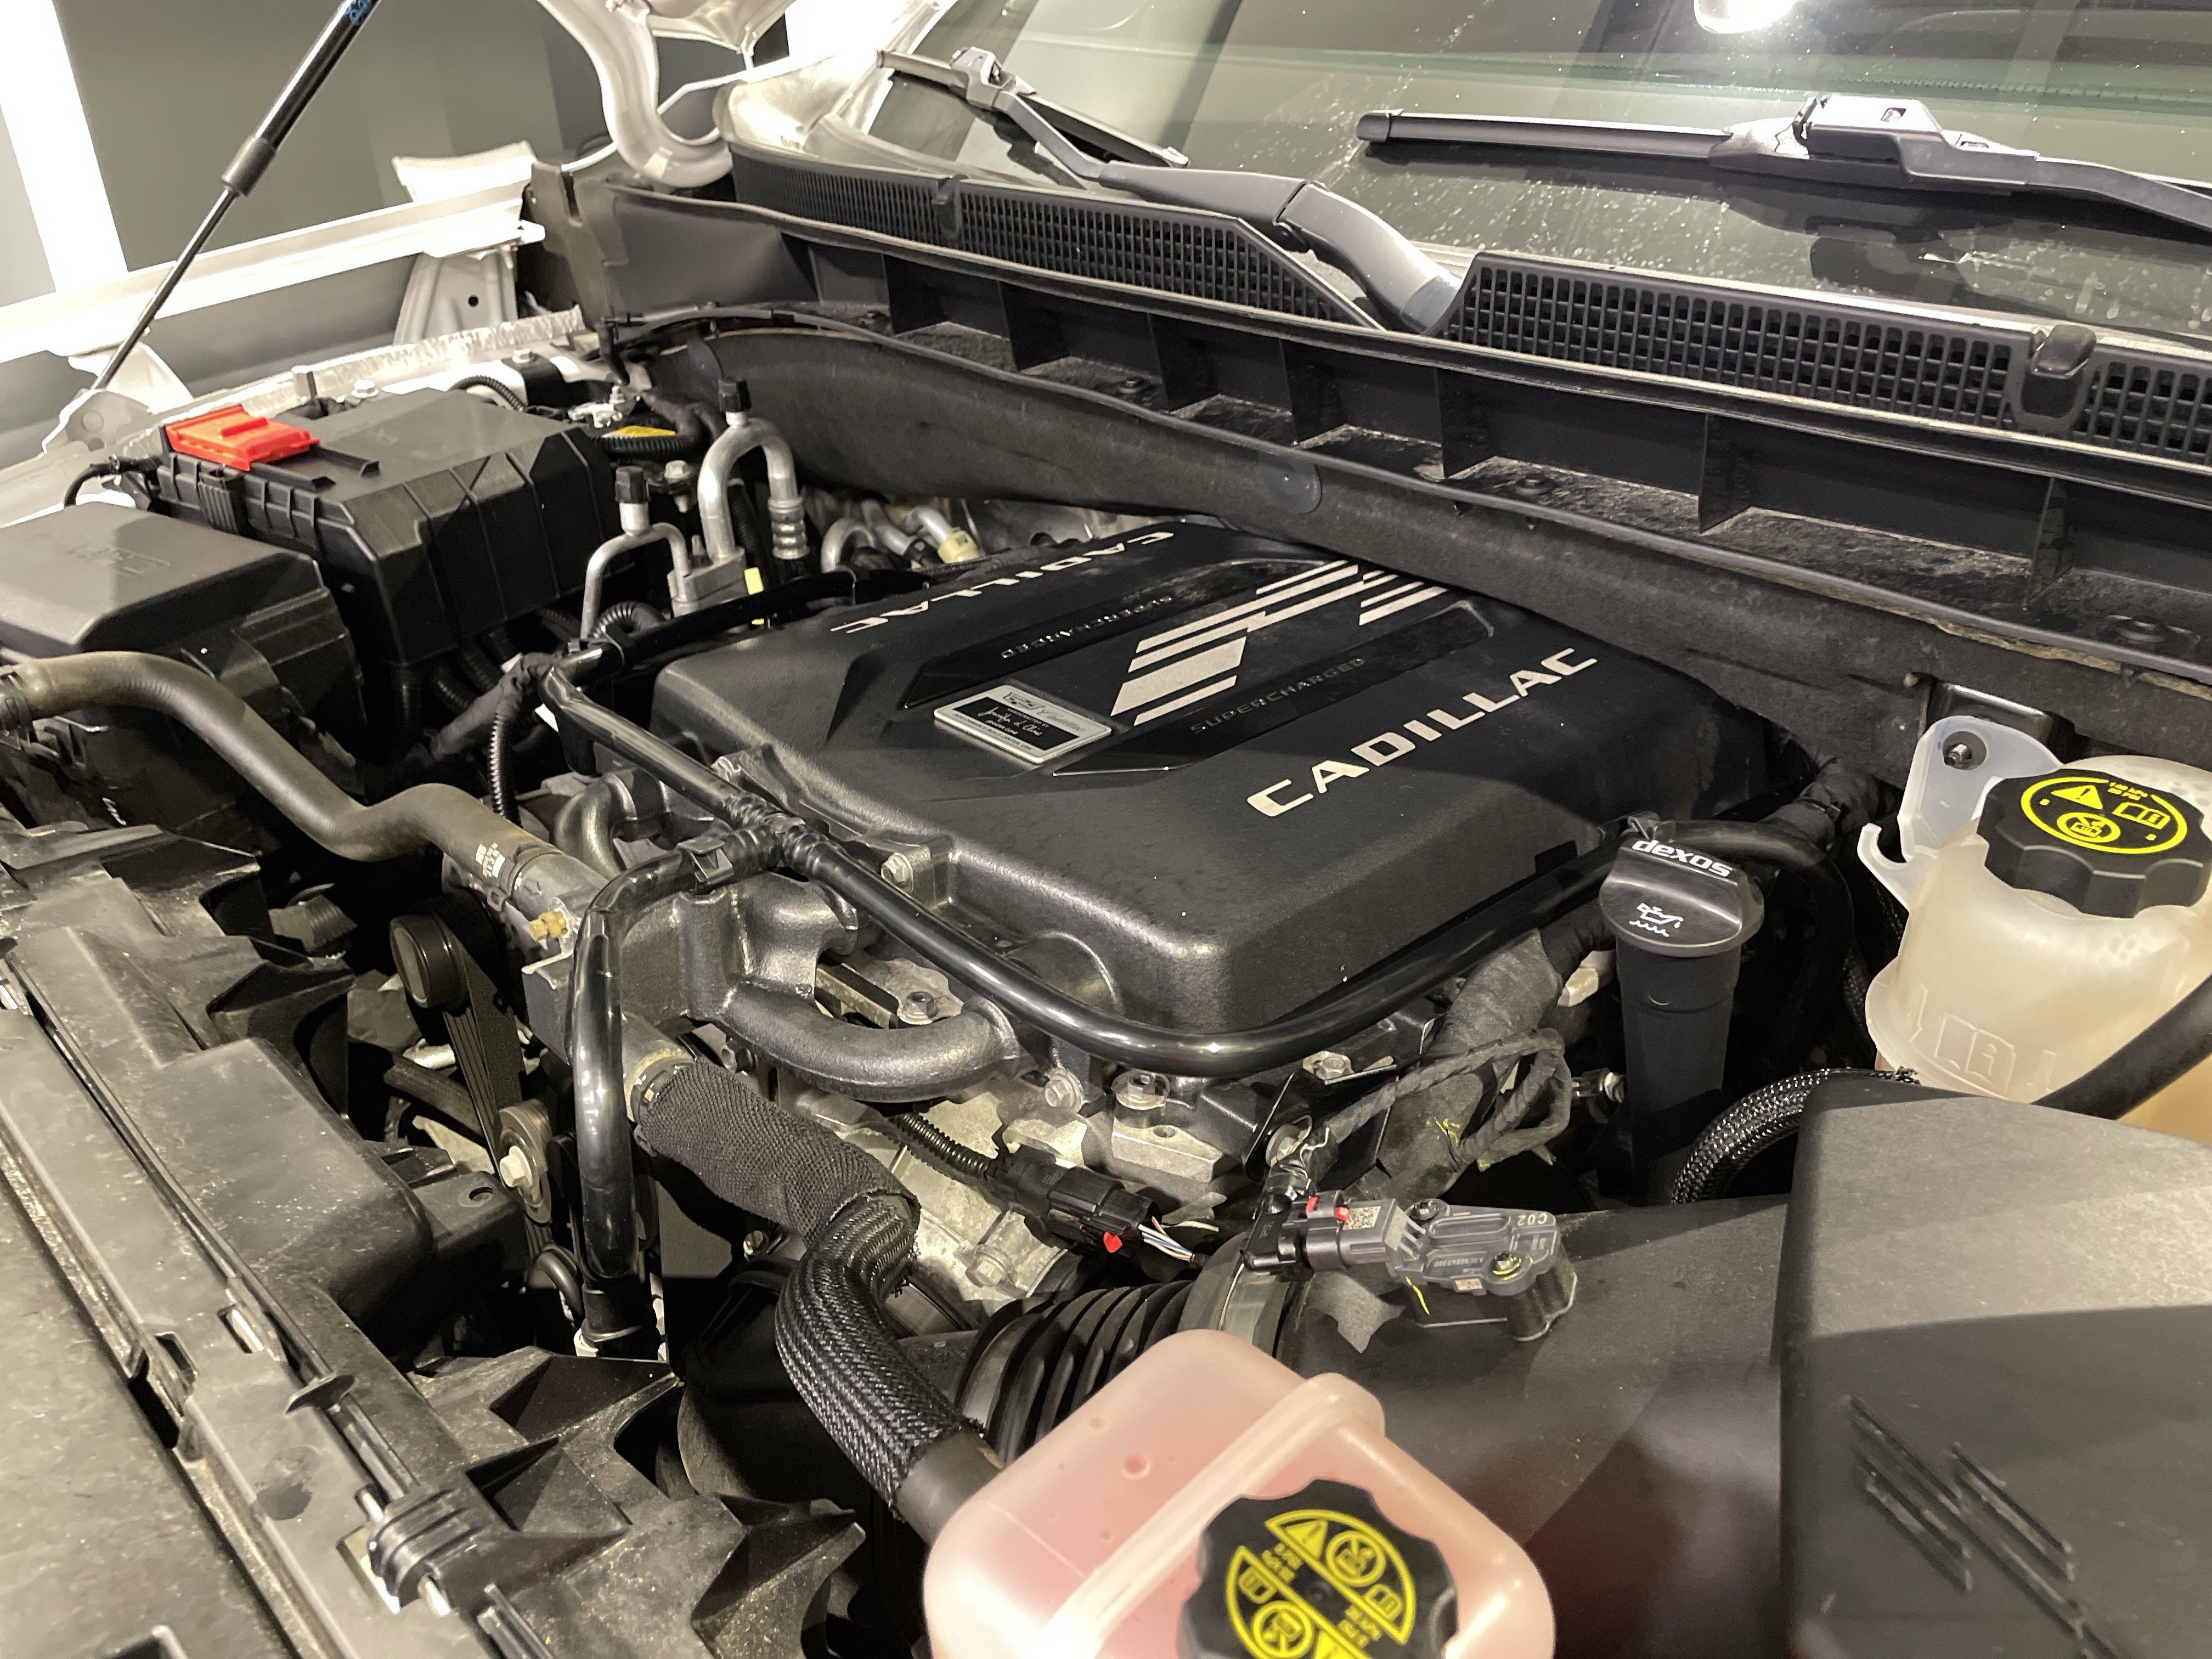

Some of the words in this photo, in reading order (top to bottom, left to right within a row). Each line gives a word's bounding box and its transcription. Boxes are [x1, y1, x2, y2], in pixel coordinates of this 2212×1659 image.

[831, 532, 1173, 634] CADILLAC
[1000, 596, 1173, 659] SUPERCHARGED
[1189, 657, 1365, 734] SUPERCHARGED
[1246, 647, 1598, 818] CADILLAC
[1632, 839, 1734, 878] dexos
